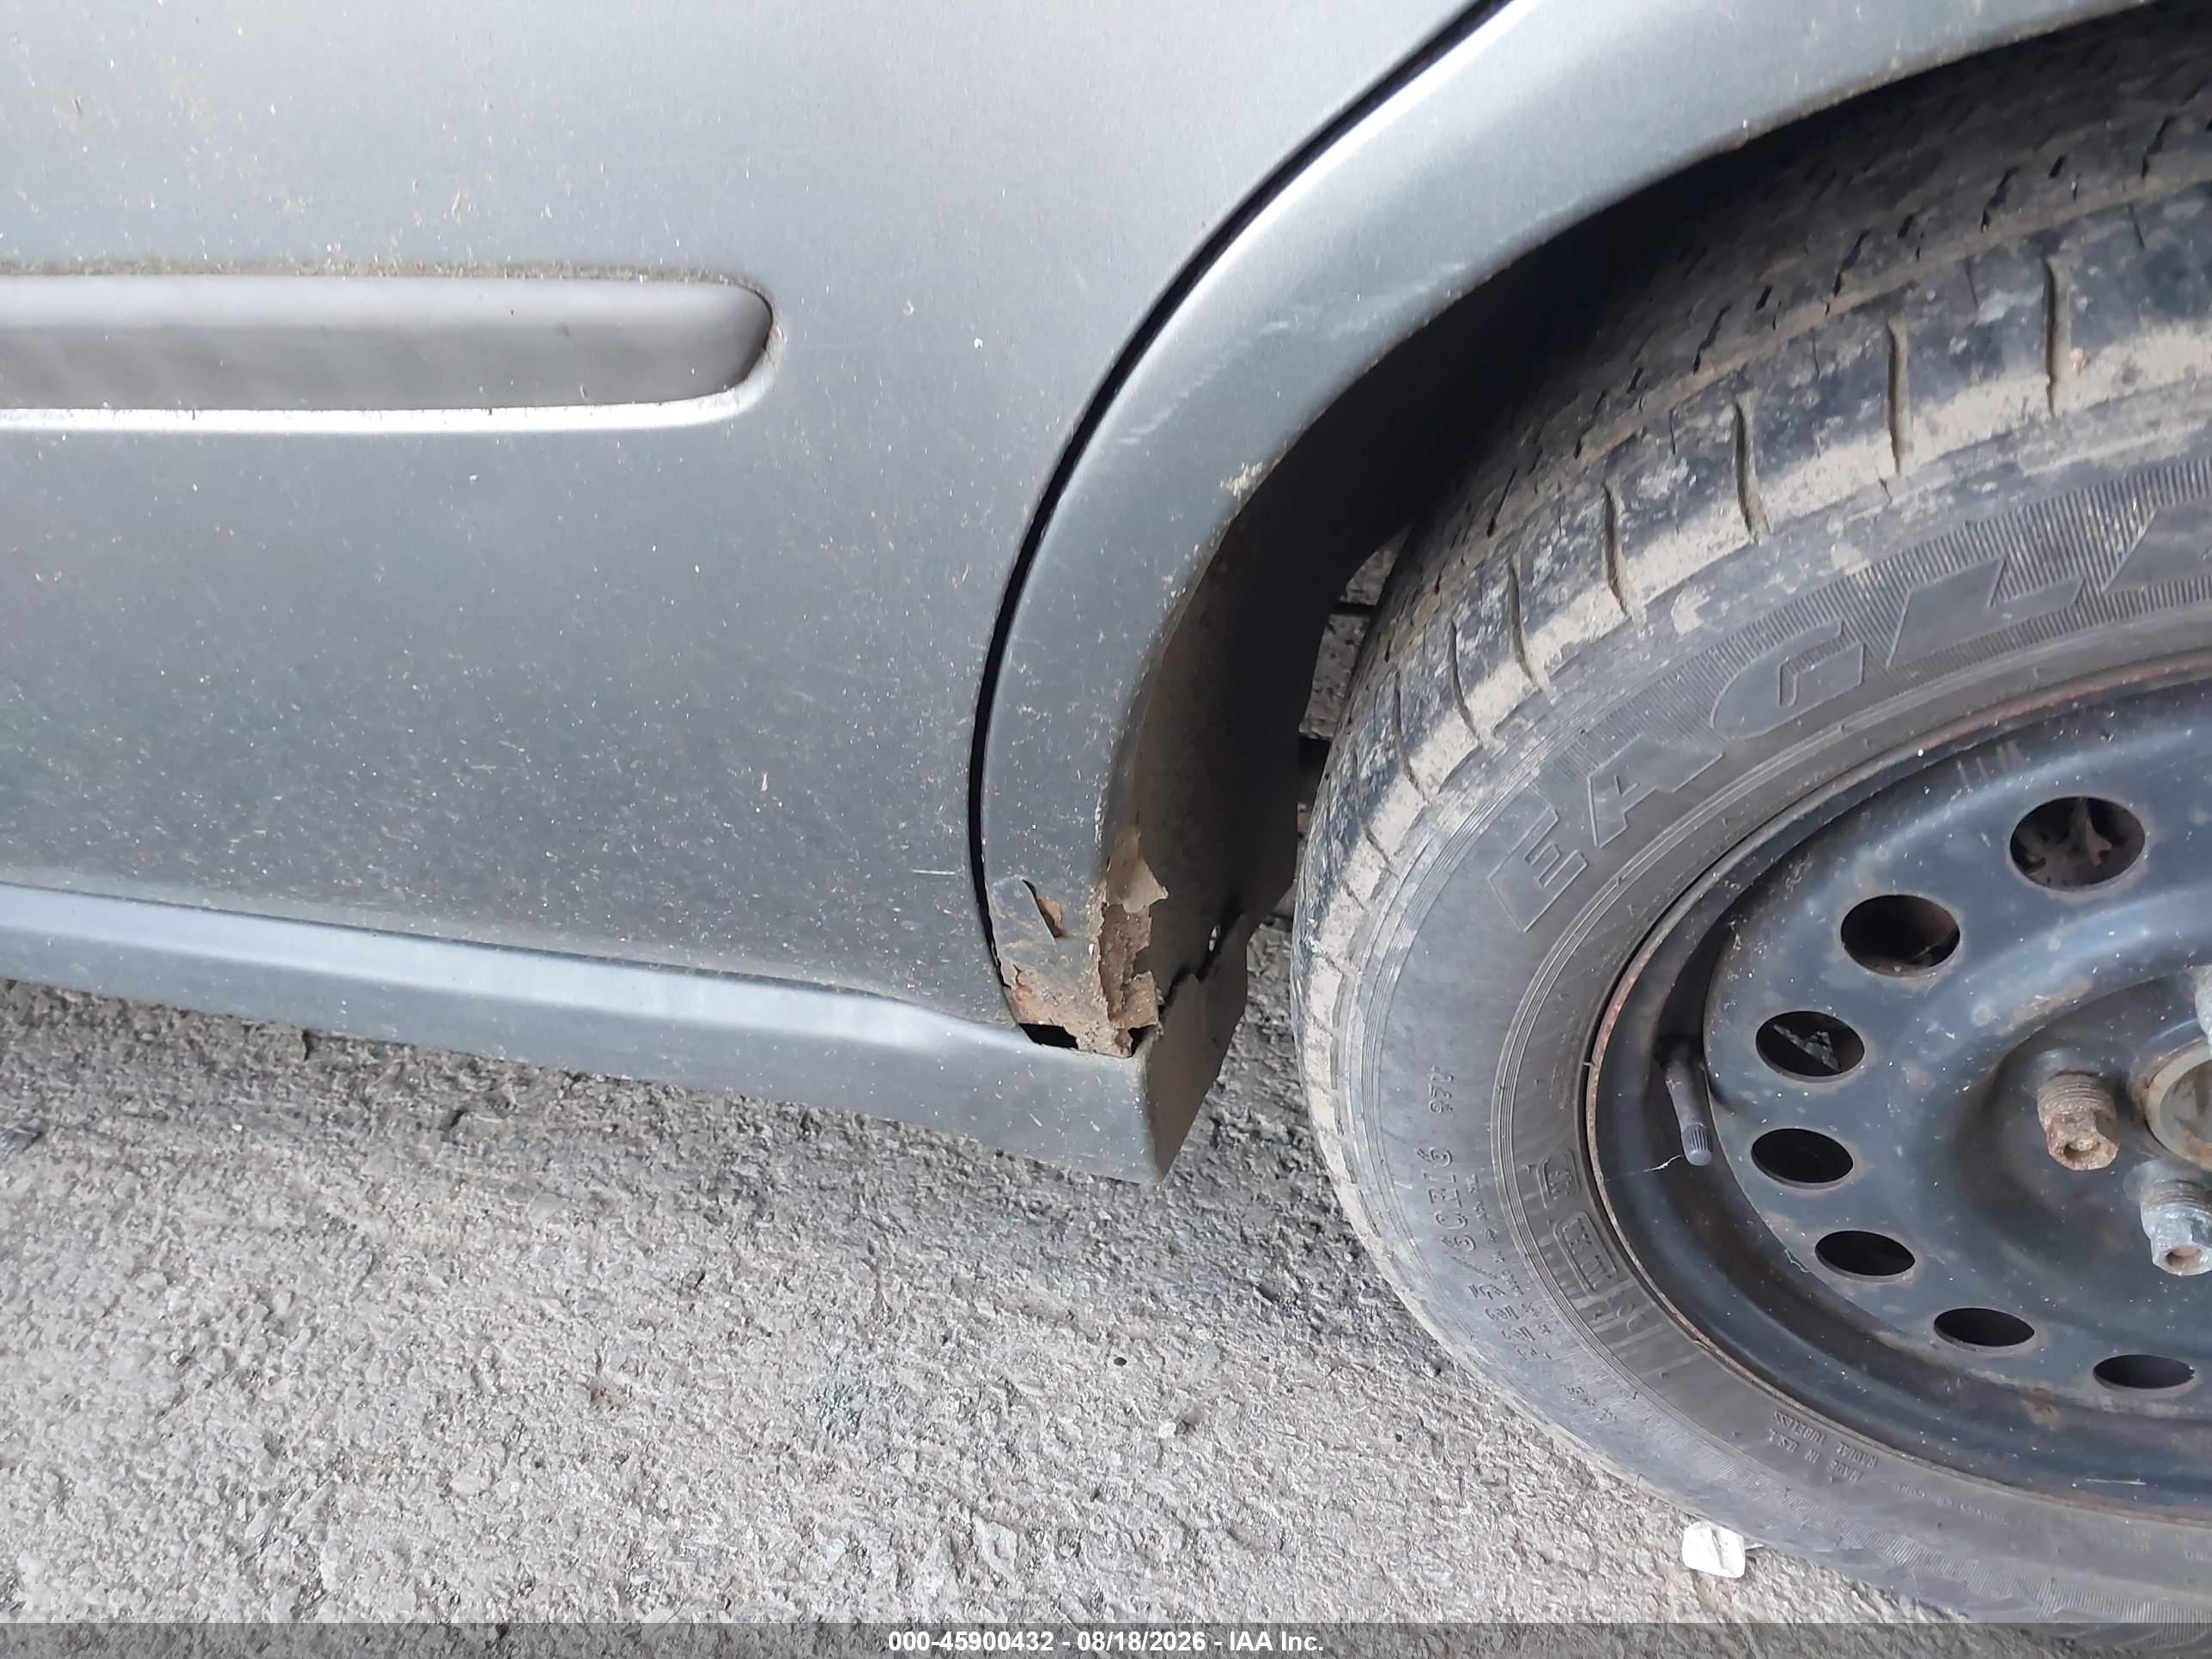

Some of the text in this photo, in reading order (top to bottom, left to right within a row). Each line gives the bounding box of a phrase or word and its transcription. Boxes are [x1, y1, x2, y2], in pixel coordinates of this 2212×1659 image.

[1772, 1410, 1879, 1469] RADIAL TUBELESS
[1804, 1449, 1820, 1464] IN
[1826, 1459, 1863, 1484] MADE
